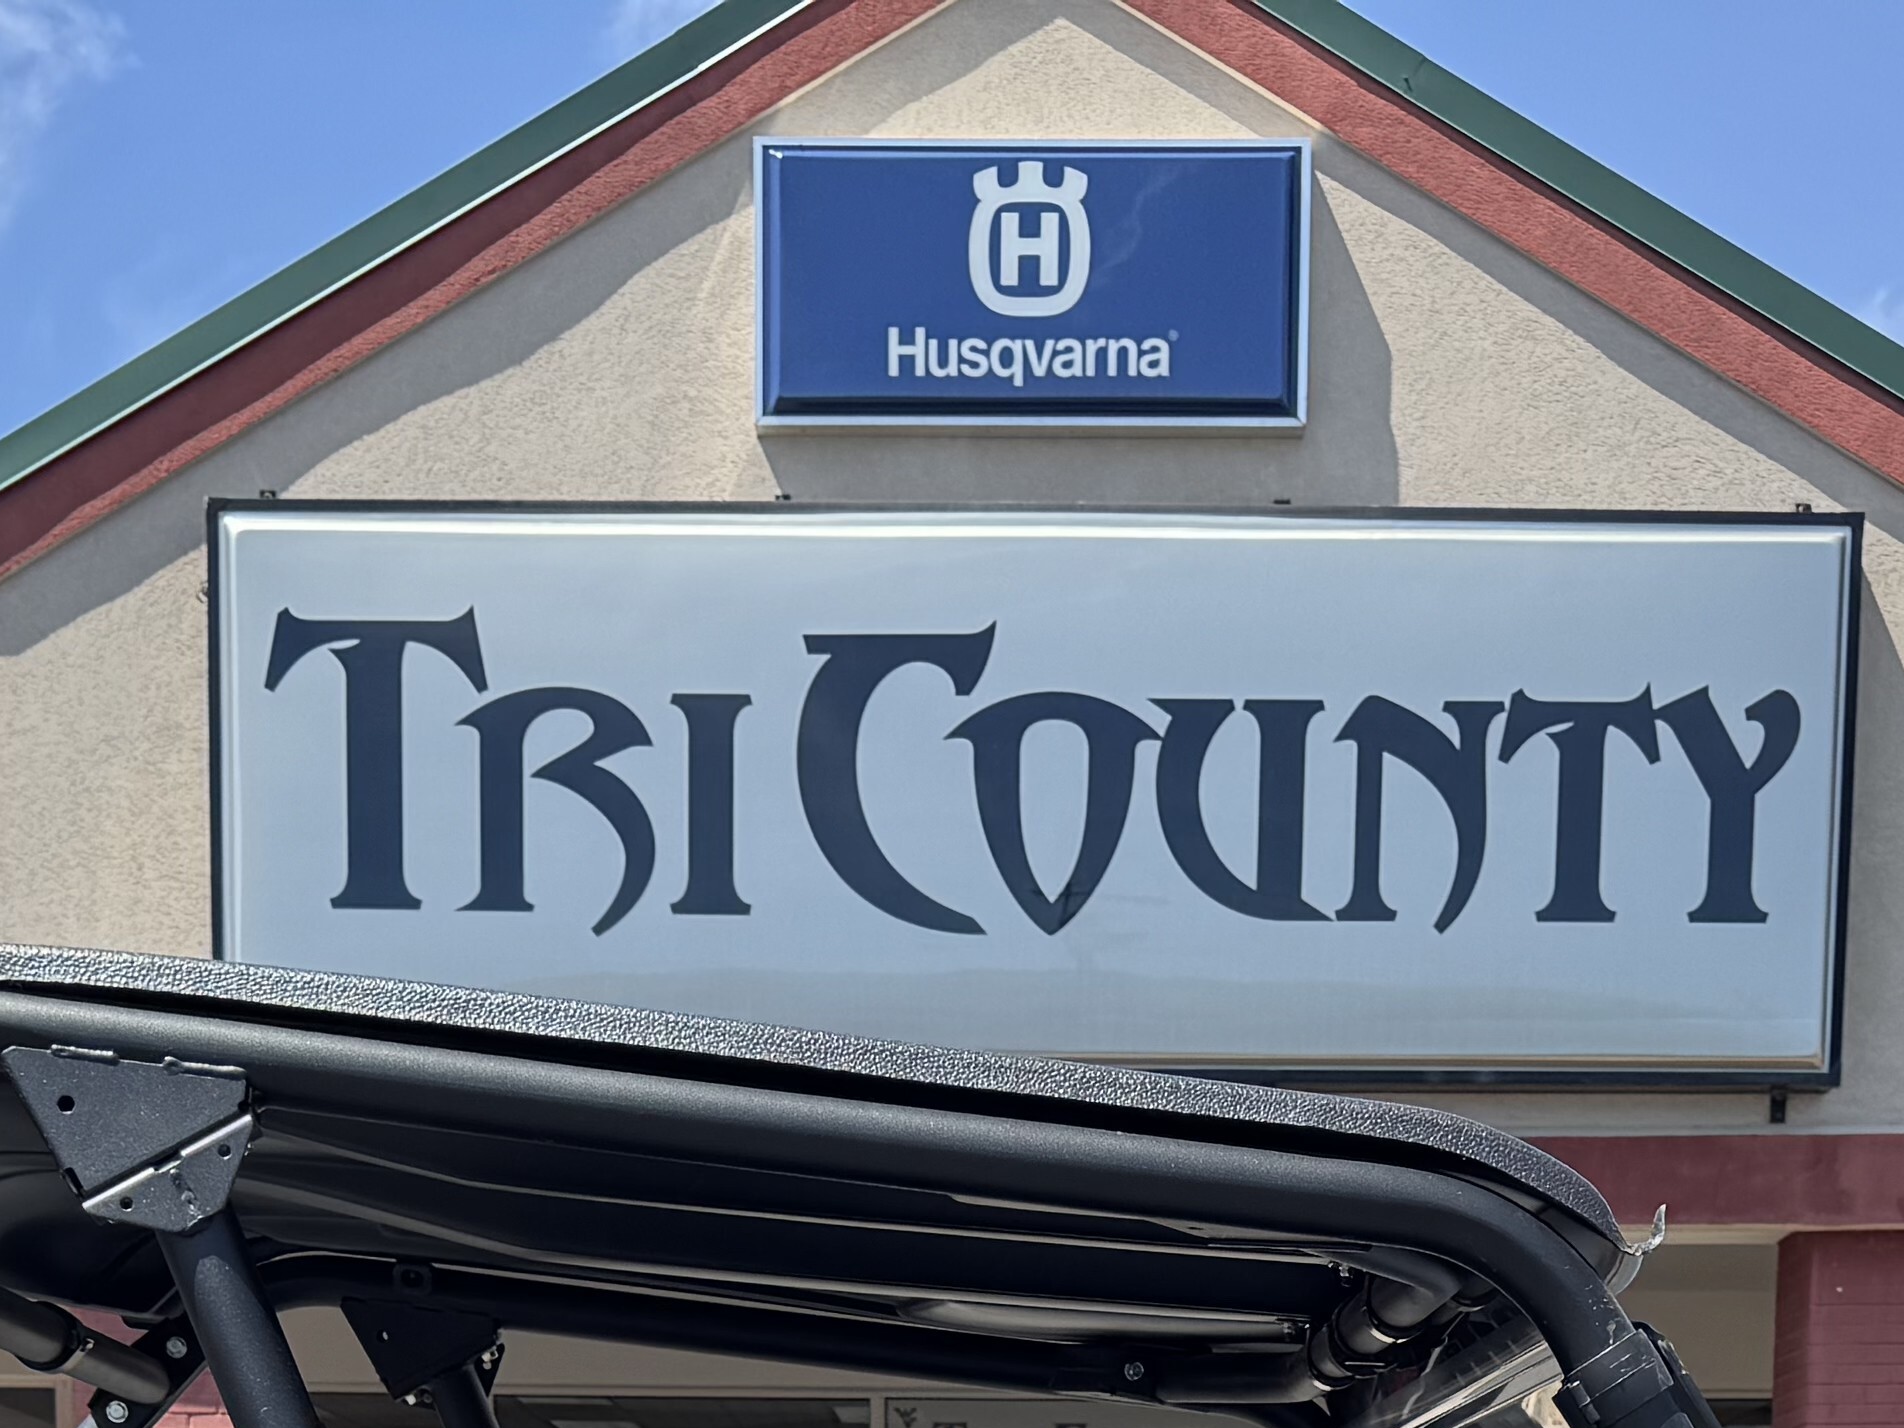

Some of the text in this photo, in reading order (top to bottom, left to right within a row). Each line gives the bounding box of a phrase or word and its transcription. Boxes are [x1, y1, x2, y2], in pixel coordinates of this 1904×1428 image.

[887, 326, 1169, 388] Husqvarna
[264, 606, 1802, 937] TRI COUNTY
